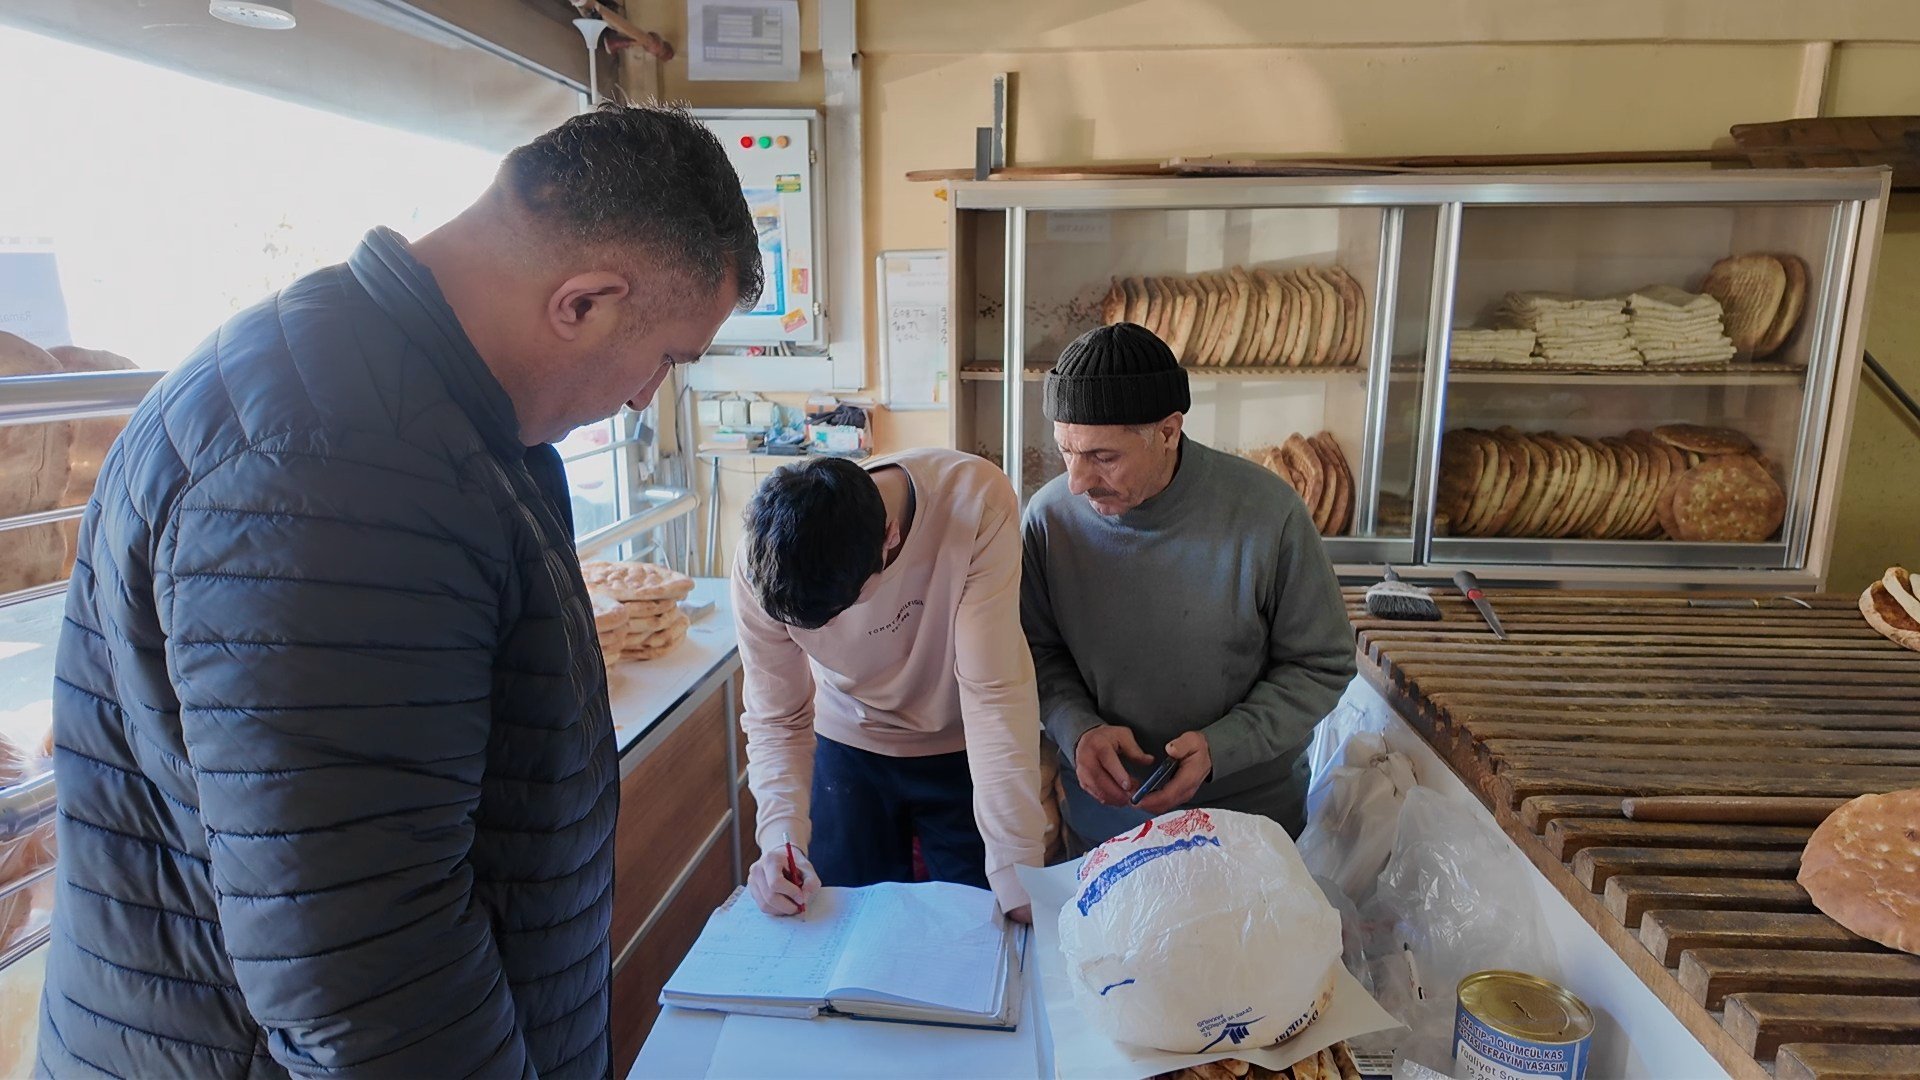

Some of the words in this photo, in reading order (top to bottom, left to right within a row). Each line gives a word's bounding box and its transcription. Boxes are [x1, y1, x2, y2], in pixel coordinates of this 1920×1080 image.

[868, 618, 896, 636] TOMMY
[1497, 1037, 1542, 1059] ÖLÜMCÜL
[1544, 1050, 1563, 1060] KAS
[1461, 1045, 1496, 1076] Faaliyet
